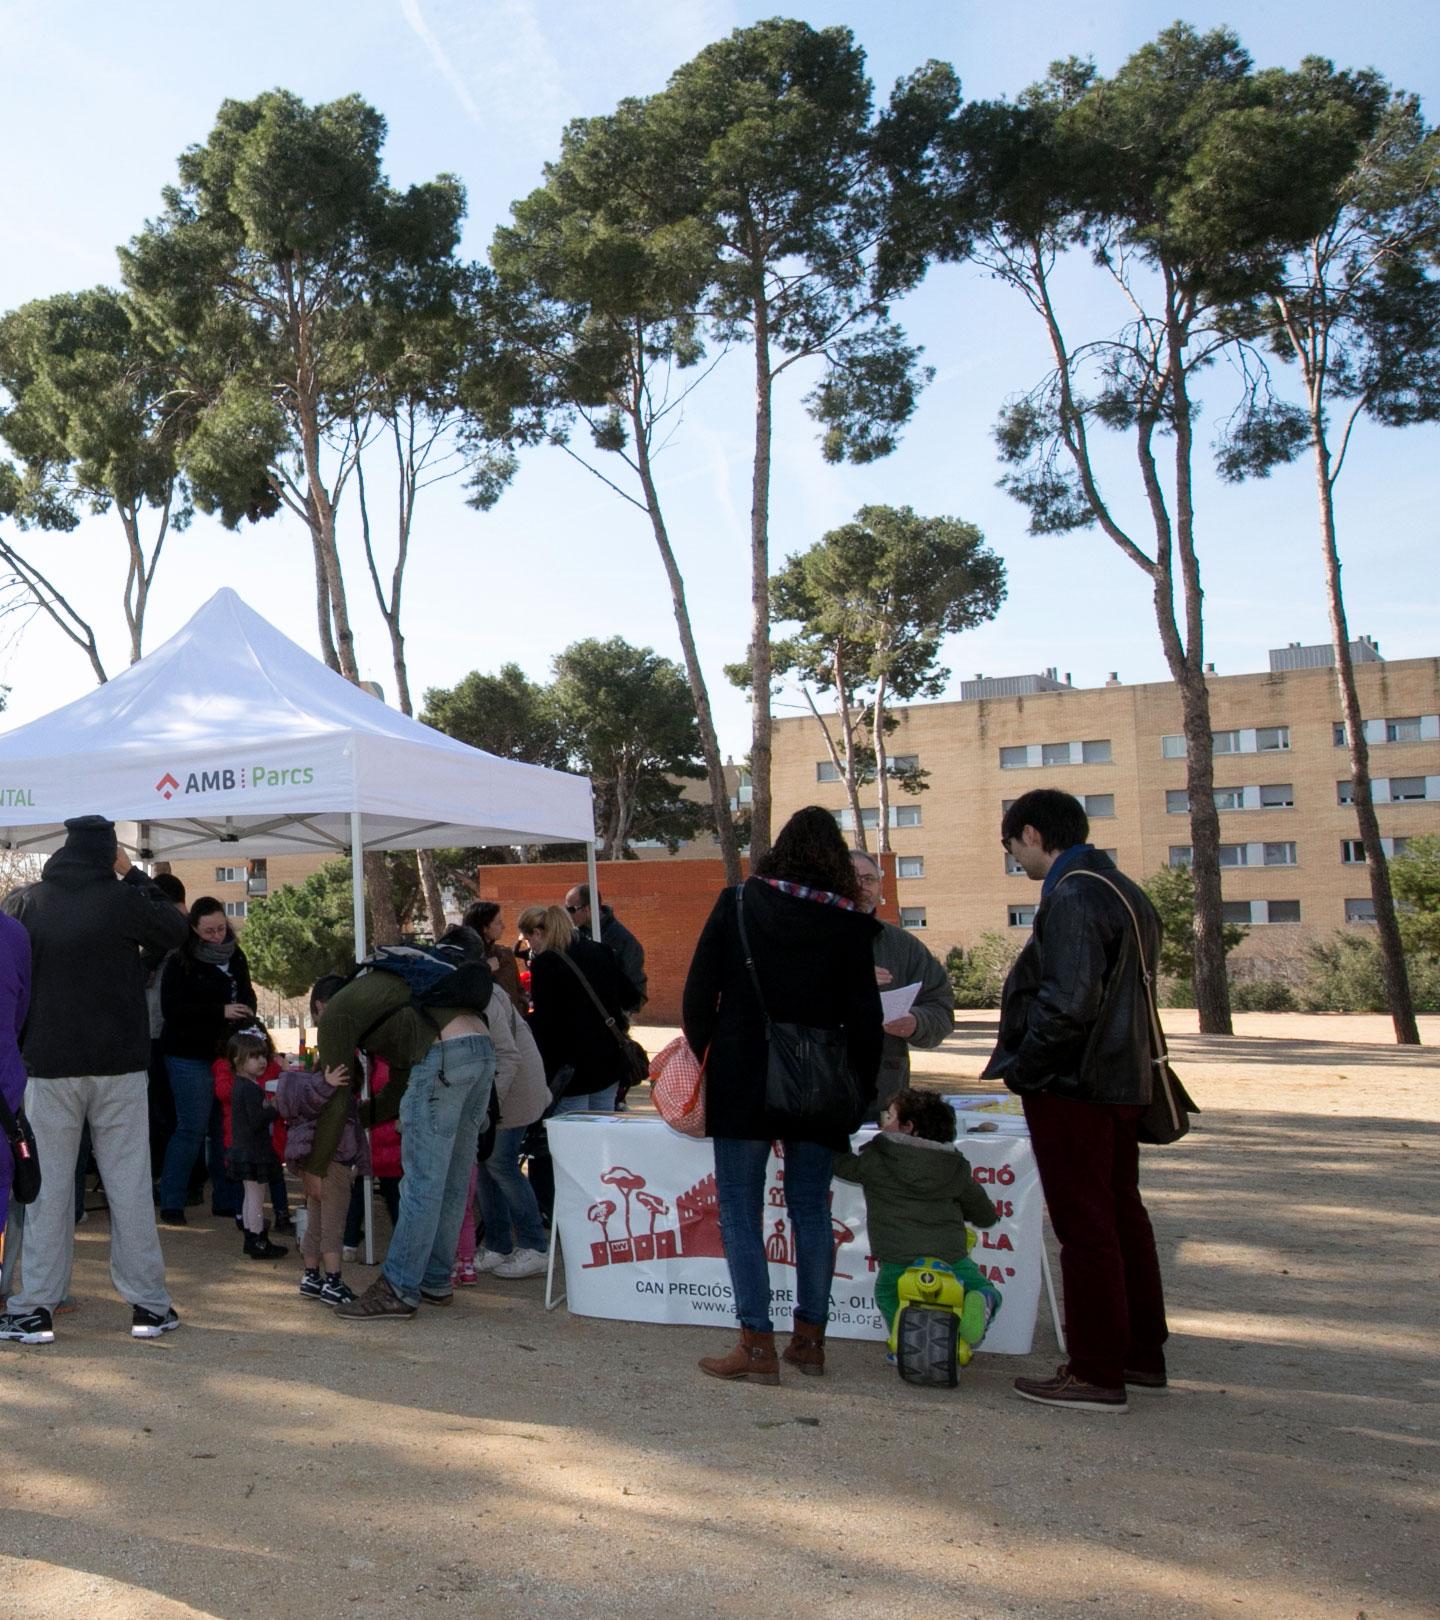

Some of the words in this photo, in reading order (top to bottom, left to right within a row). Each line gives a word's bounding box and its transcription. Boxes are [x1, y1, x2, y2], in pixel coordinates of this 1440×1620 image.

[185, 769, 236, 794] AMB
[252, 766, 314, 788] Parcs
[982, 1231, 1015, 1252] LA
[636, 1281, 664, 1295] CAN
[669, 1282, 732, 1299] PRECIÓS
